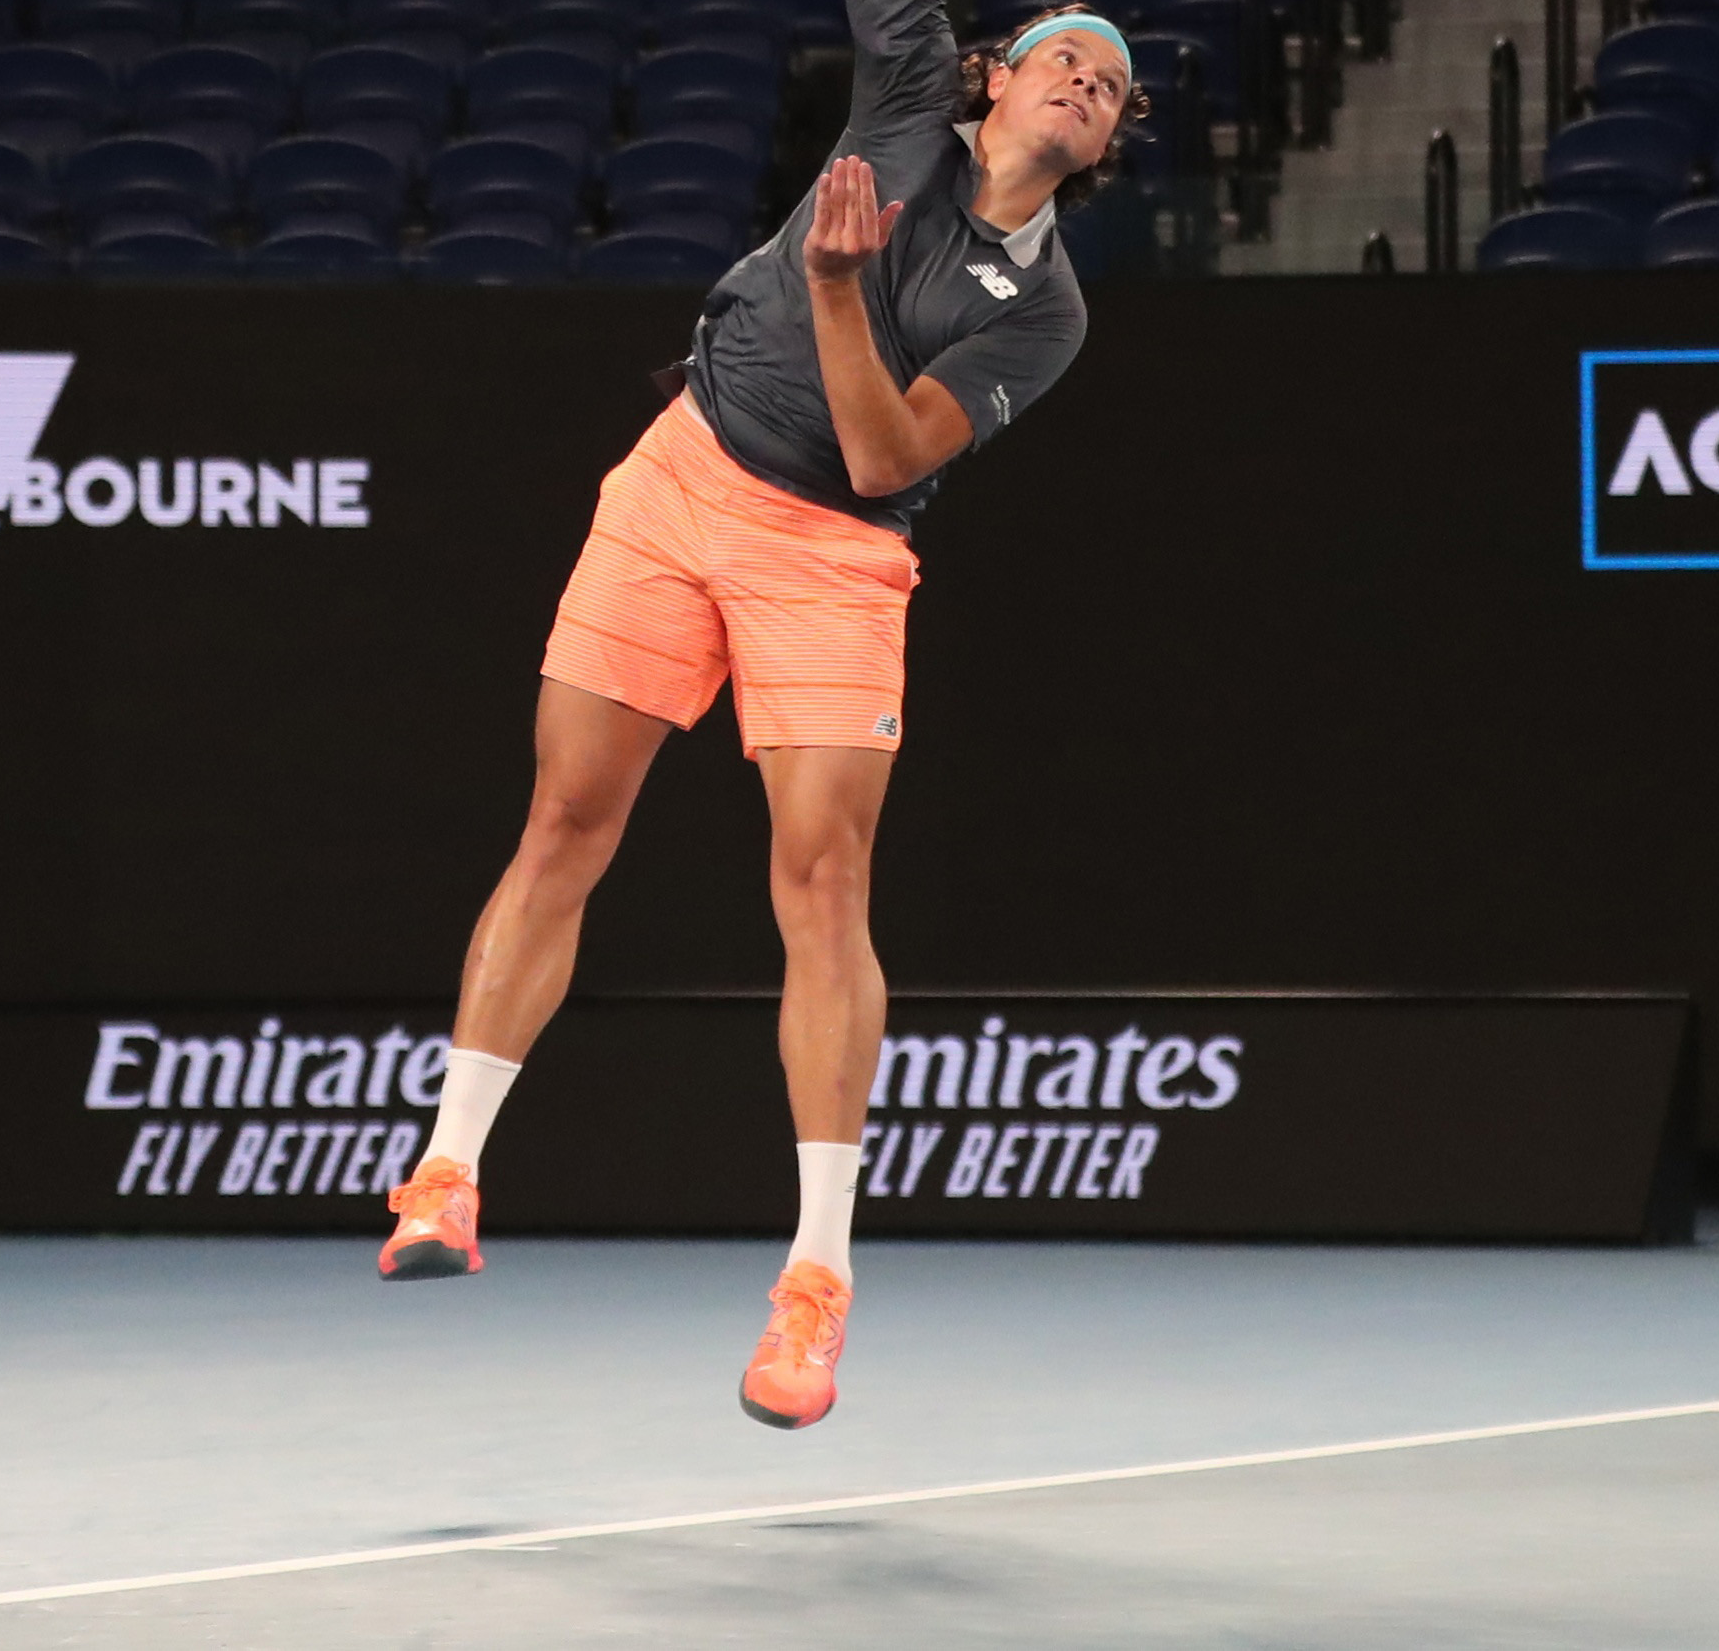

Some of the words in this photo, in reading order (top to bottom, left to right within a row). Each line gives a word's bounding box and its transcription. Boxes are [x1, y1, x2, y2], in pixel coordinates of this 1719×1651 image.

[85, 1017, 452, 1110] Emirate
[868, 1015, 1243, 1111] mirates
[116, 1122, 221, 1197] FLY
[217, 1121, 421, 1197] BETTER
[944, 1123, 1161, 1200] BETTER
